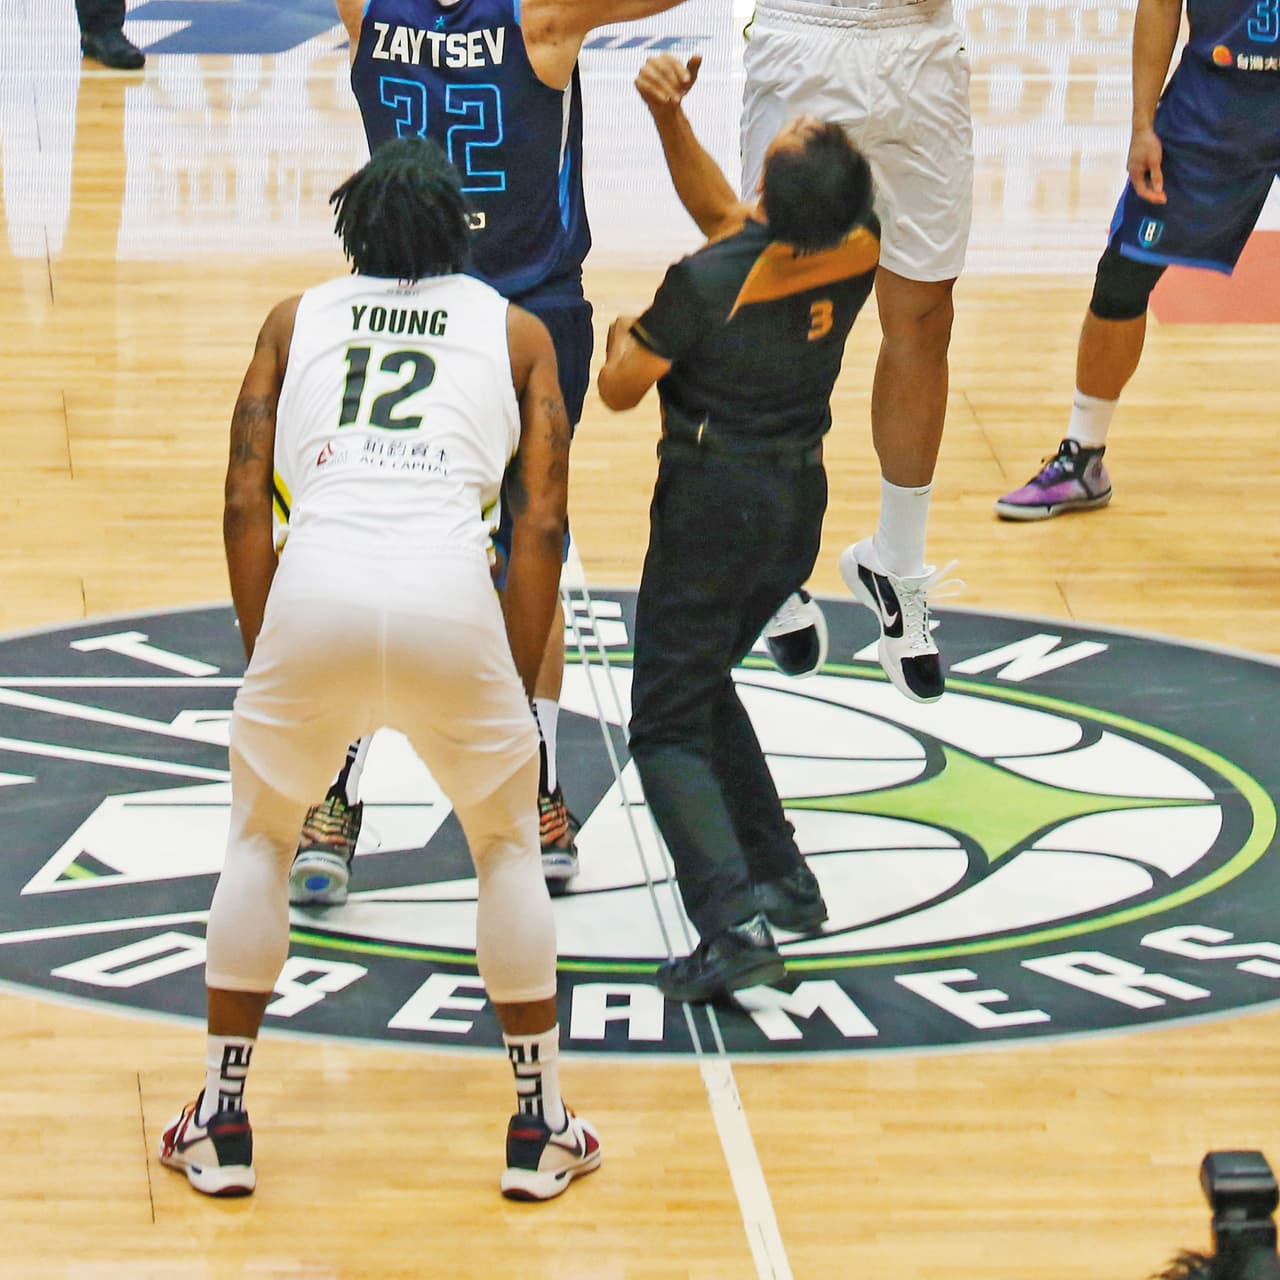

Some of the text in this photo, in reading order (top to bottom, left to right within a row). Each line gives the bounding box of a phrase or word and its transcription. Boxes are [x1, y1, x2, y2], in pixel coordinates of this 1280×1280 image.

[371, 21, 507, 70] ZAYTSEV
[350, 304, 449, 337] YOUNG
[807, 299, 835, 341] 3
[337, 344, 438, 432] 12
